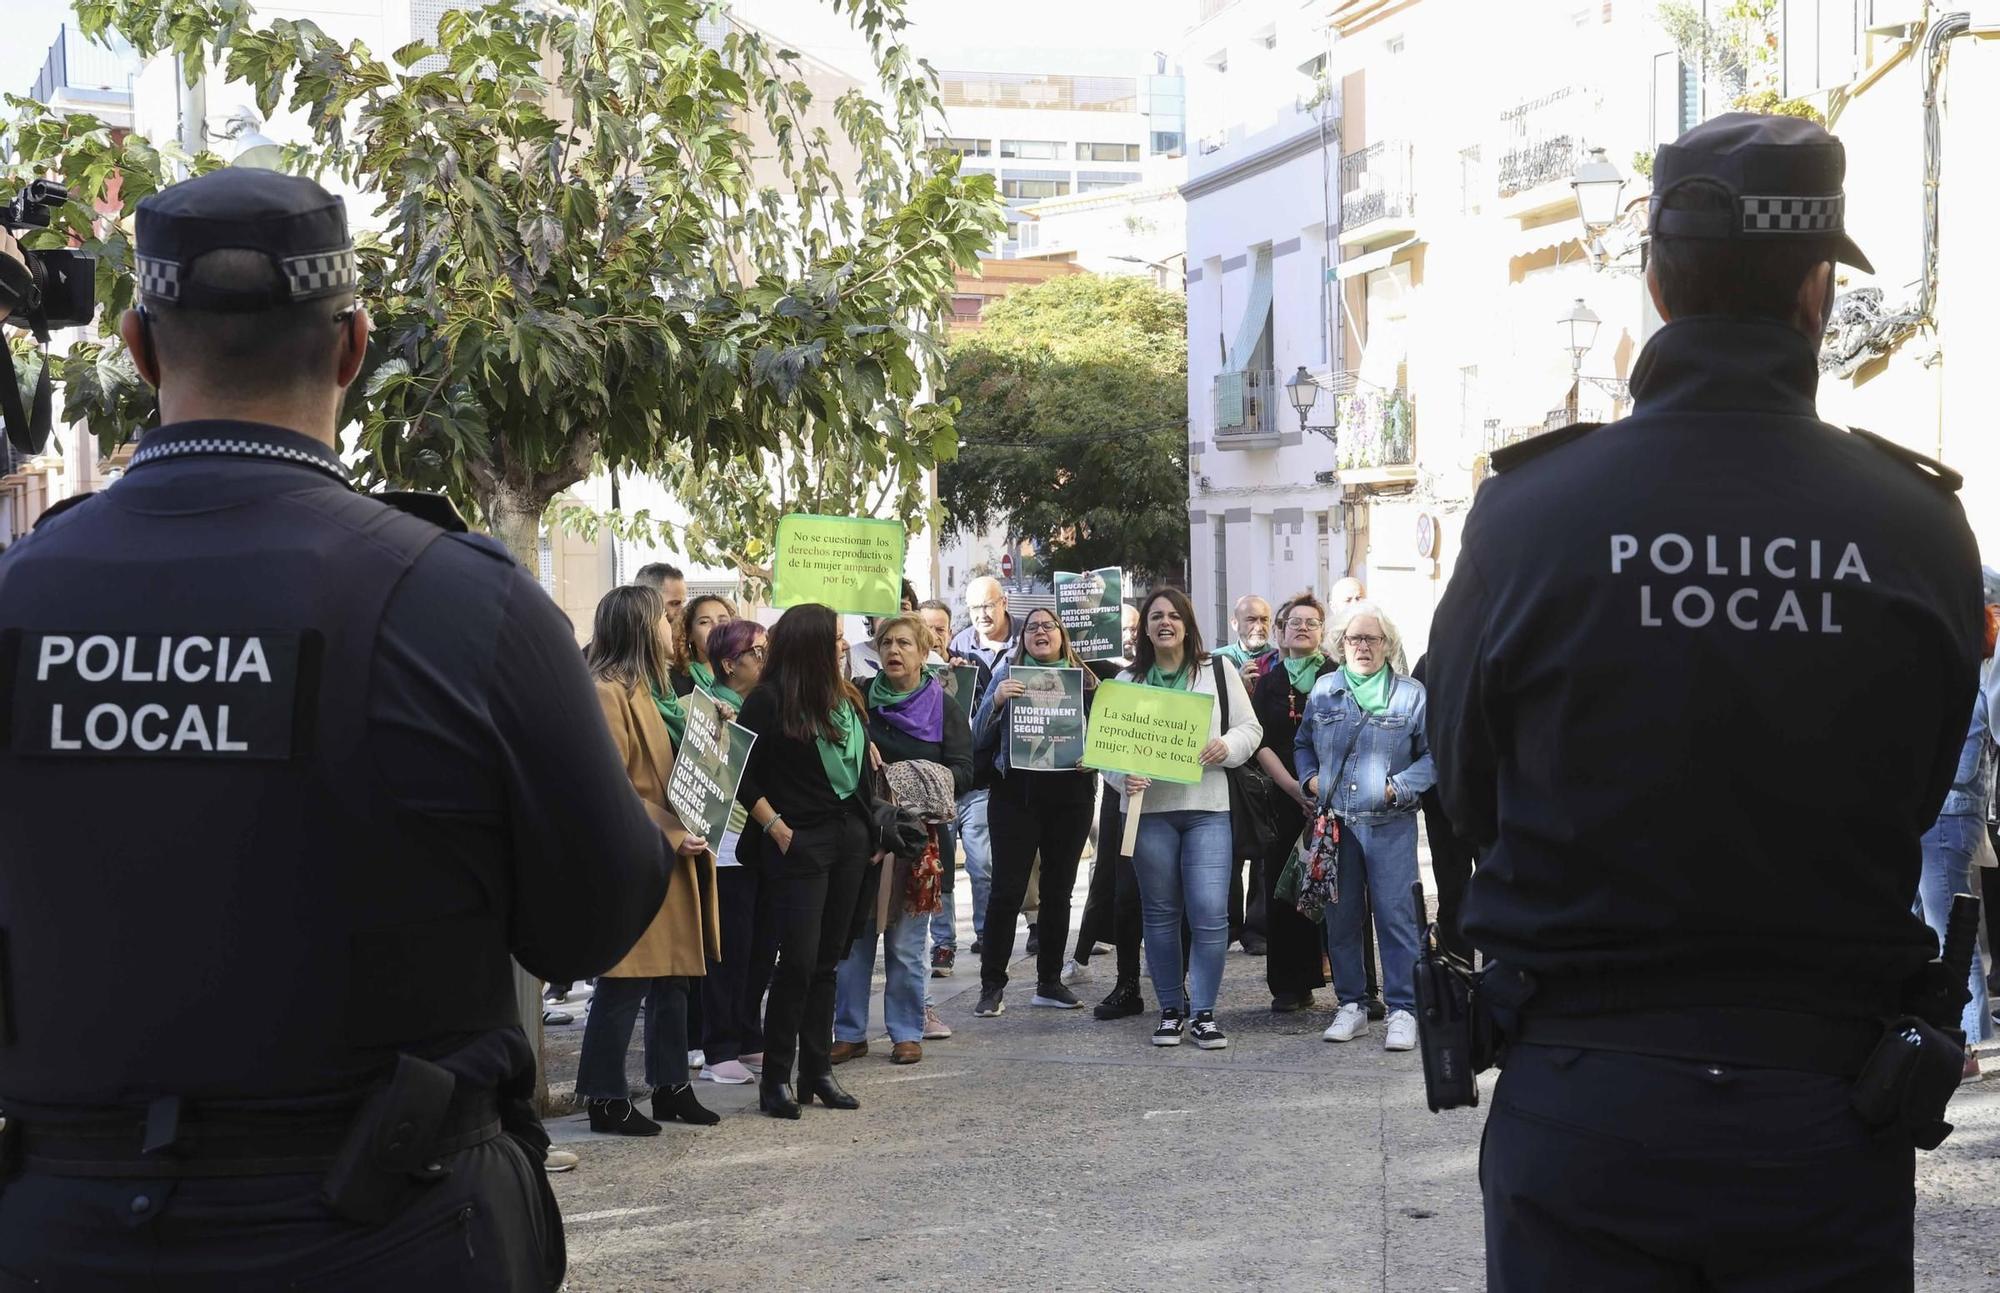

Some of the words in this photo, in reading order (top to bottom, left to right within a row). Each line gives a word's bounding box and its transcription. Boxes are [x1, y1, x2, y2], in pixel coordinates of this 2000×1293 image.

[793, 531, 808, 542] No
[811, 535, 821, 543] se
[823, 535, 872, 546] cuestionan
[877, 537, 890, 547] los
[788, 545, 830, 557] derechos
[832, 549, 893, 561] reproductivos
[788, 558, 800, 568] de
[803, 559, 811, 569] la
[814, 562, 842, 572] mujer
[1610, 533, 1872, 583] POLICIA
[823, 575, 839, 585] por
[1060, 582, 1097, 590] EDUCACIÓN
[1061, 606, 1120, 616] ANTICONCEPTIVOS
[1640, 585, 1842, 633] LOCAL
[1090, 638, 1110, 646] LEGAL
[1092, 643, 1114, 652] MORIR
[36, 635, 272, 683] POLICIA
[692, 706, 705, 723] NO
[705, 716, 717, 737] LES
[1014, 706, 1077, 717] AVORTAMENT
[1014, 715, 1045, 725] LLIURE
[1046, 717, 1050, 725] I
[1103, 707, 1118, 719] La
[1120, 712, 1150, 725] salud
[1152, 717, 1188, 731] sexual
[1189, 723, 1198, 735] y
[50, 703, 249, 751] LOCAL
[1014, 724, 1044, 734] SEGUR
[1099, 725, 1168, 744] reproductiva
[1170, 734, 1184, 746] de
[1187, 736, 1197, 748] la
[687, 729, 706, 757] VIDA,
[690, 719, 718, 757] IMPORTA
[718, 750, 729, 766] LA
[1095, 740, 1129, 754] mujer,
[1133, 744, 1153, 757] NO
[1155, 750, 1168, 759] se
[1170, 752, 1196, 764] toca.
[676, 766, 693, 786] QUE
[693, 779, 707, 800] LAS
[680, 753, 693, 771] LES
[694, 768, 725, 803] MOLESTA
[672, 777, 706, 814] MUJERES
[670, 790, 712, 835] DECIDAMOS
